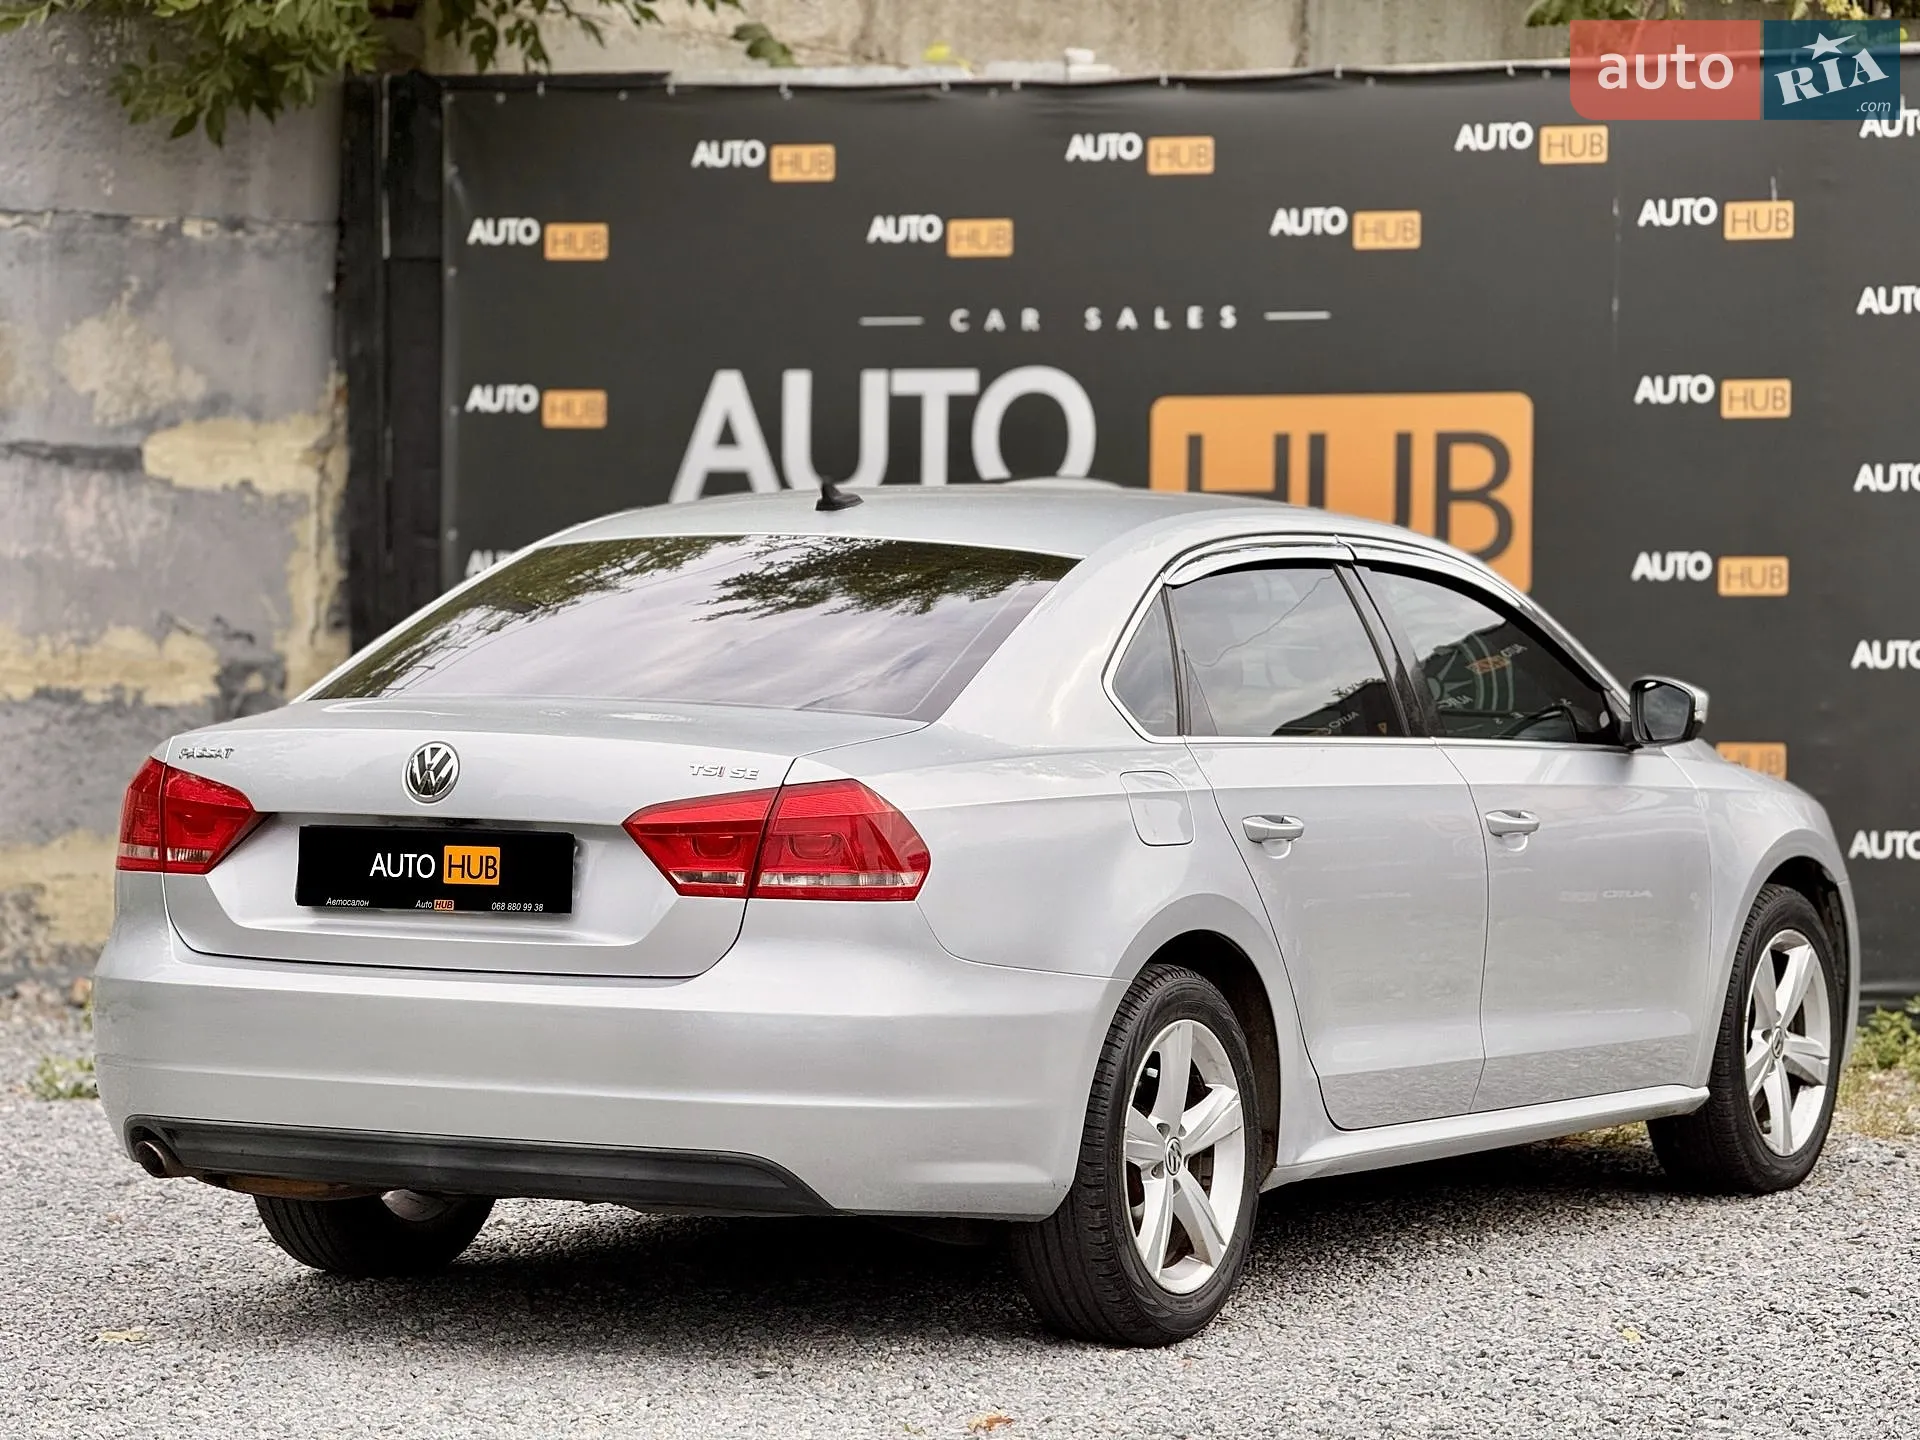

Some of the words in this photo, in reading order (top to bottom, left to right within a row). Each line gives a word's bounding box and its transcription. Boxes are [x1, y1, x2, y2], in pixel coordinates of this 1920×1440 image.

[1454, 121, 1535, 152] AUTO
[1544, 131, 1605, 159] HUB
[1858, 109, 1920, 138] AUT
[691, 140, 766, 168] AUTO
[776, 151, 832, 177] HUB
[1065, 132, 1144, 161] AUTO
[1152, 142, 1212, 170] HUB
[867, 214, 943, 243] AUTO
[952, 225, 1010, 252] HUB
[1269, 206, 1348, 236] AUTO
[1358, 217, 1418, 245] HUB
[1637, 197, 1718, 228] AUTO
[1729, 206, 1791, 235] HUB
[467, 218, 540, 246] AUTO
[550, 230, 605, 255] HUB
[949, 307, 1040, 333] CAR
[1084, 304, 1239, 332] SALES
[1856, 285, 1920, 315] AUT
[465, 385, 539, 413] AUTO
[548, 397, 603, 422] HUB
[1634, 374, 1715, 404] AUTO
[1726, 385, 1788, 413] HUB
[668, 364, 1097, 503] AUTO
[1631, 551, 1713, 581] AUTO
[1723, 563, 1785, 591] HUB
[689, 764, 726, 778] TSI
[729, 767, 760, 781] SE
[369, 853, 436, 878] AUTO
[447, 853, 499, 880] HUB
[325, 897, 370, 907] Автосалон
[415, 900, 433, 909] Auto
[435, 900, 454, 909] HUB
[491, 902, 506, 911] 068
[507, 902, 522, 911] 880
[523, 902, 533, 912] 99
[534, 903, 544, 912] 38
